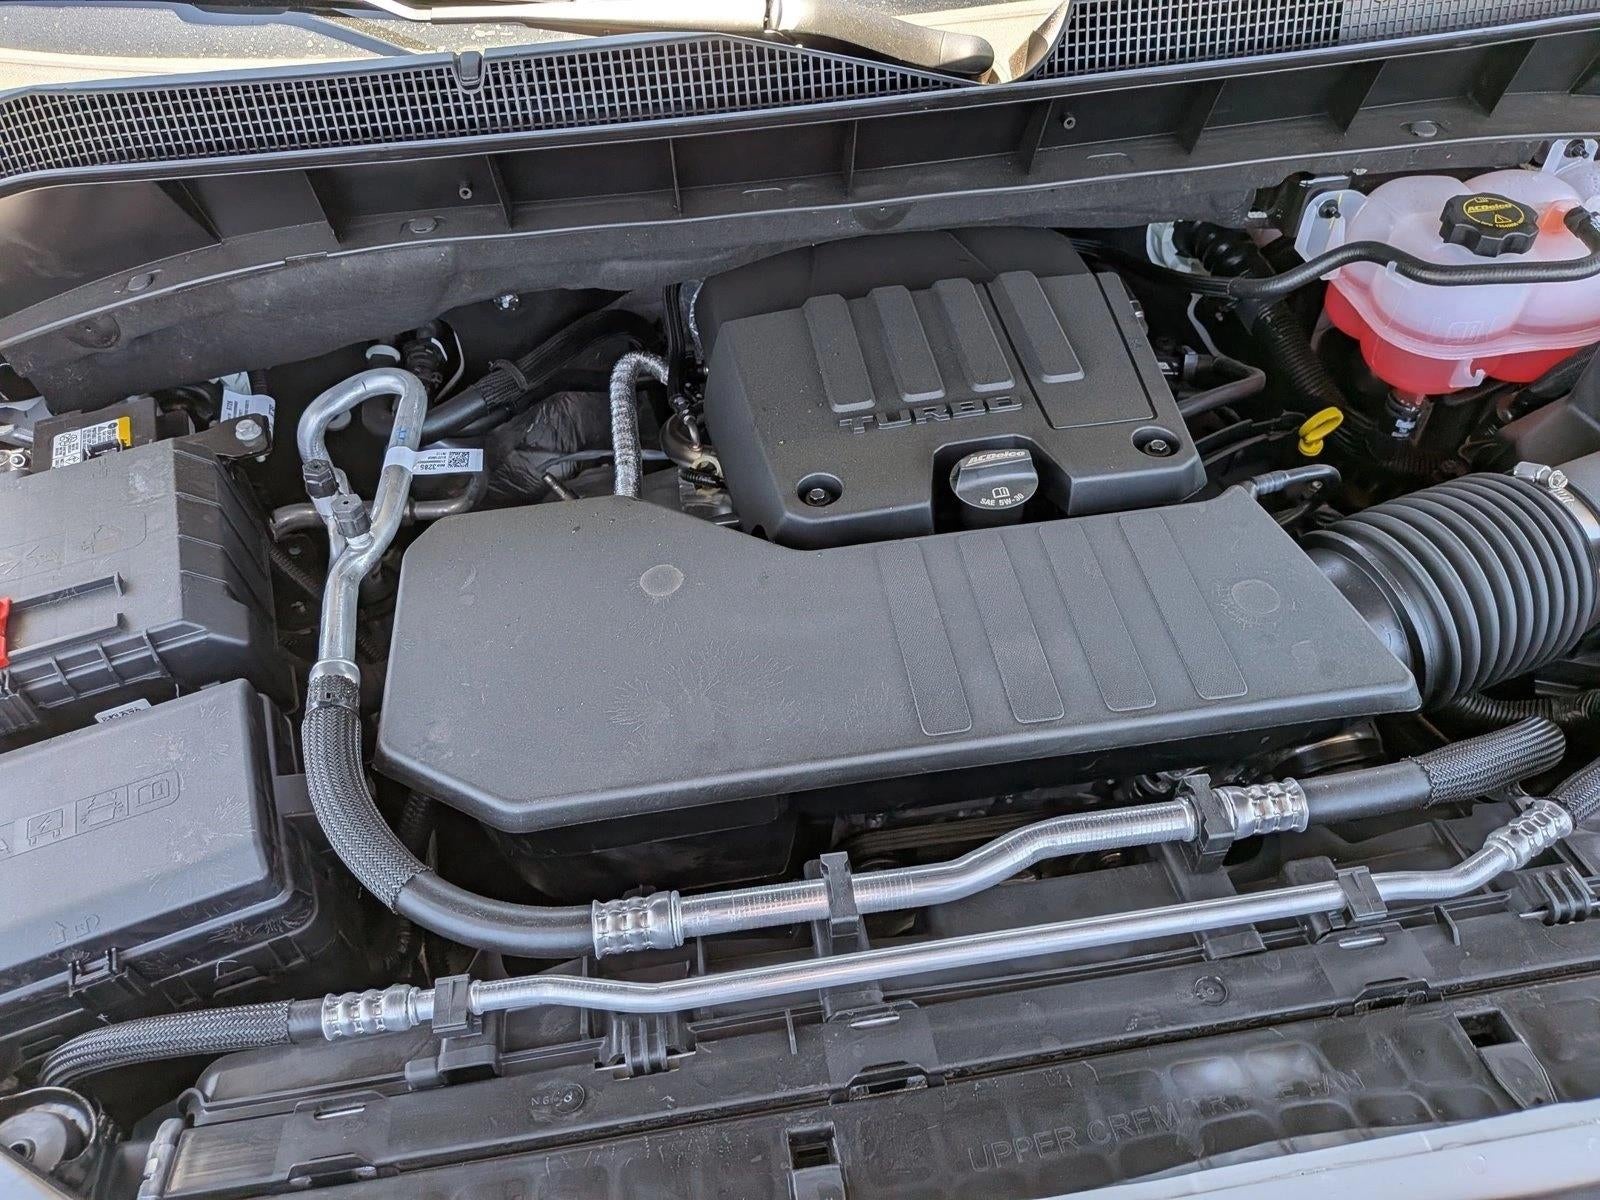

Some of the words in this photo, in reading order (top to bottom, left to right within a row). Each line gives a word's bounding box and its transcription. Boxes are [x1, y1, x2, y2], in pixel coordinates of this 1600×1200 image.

[839, 397, 1023, 434] TURBO
[967, 451, 1026, 466] ACDelco
[980, 498, 996, 506] SAE
[999, 493, 1025, 506] 5W-30
[967, 1126, 1080, 1172] UPPER
